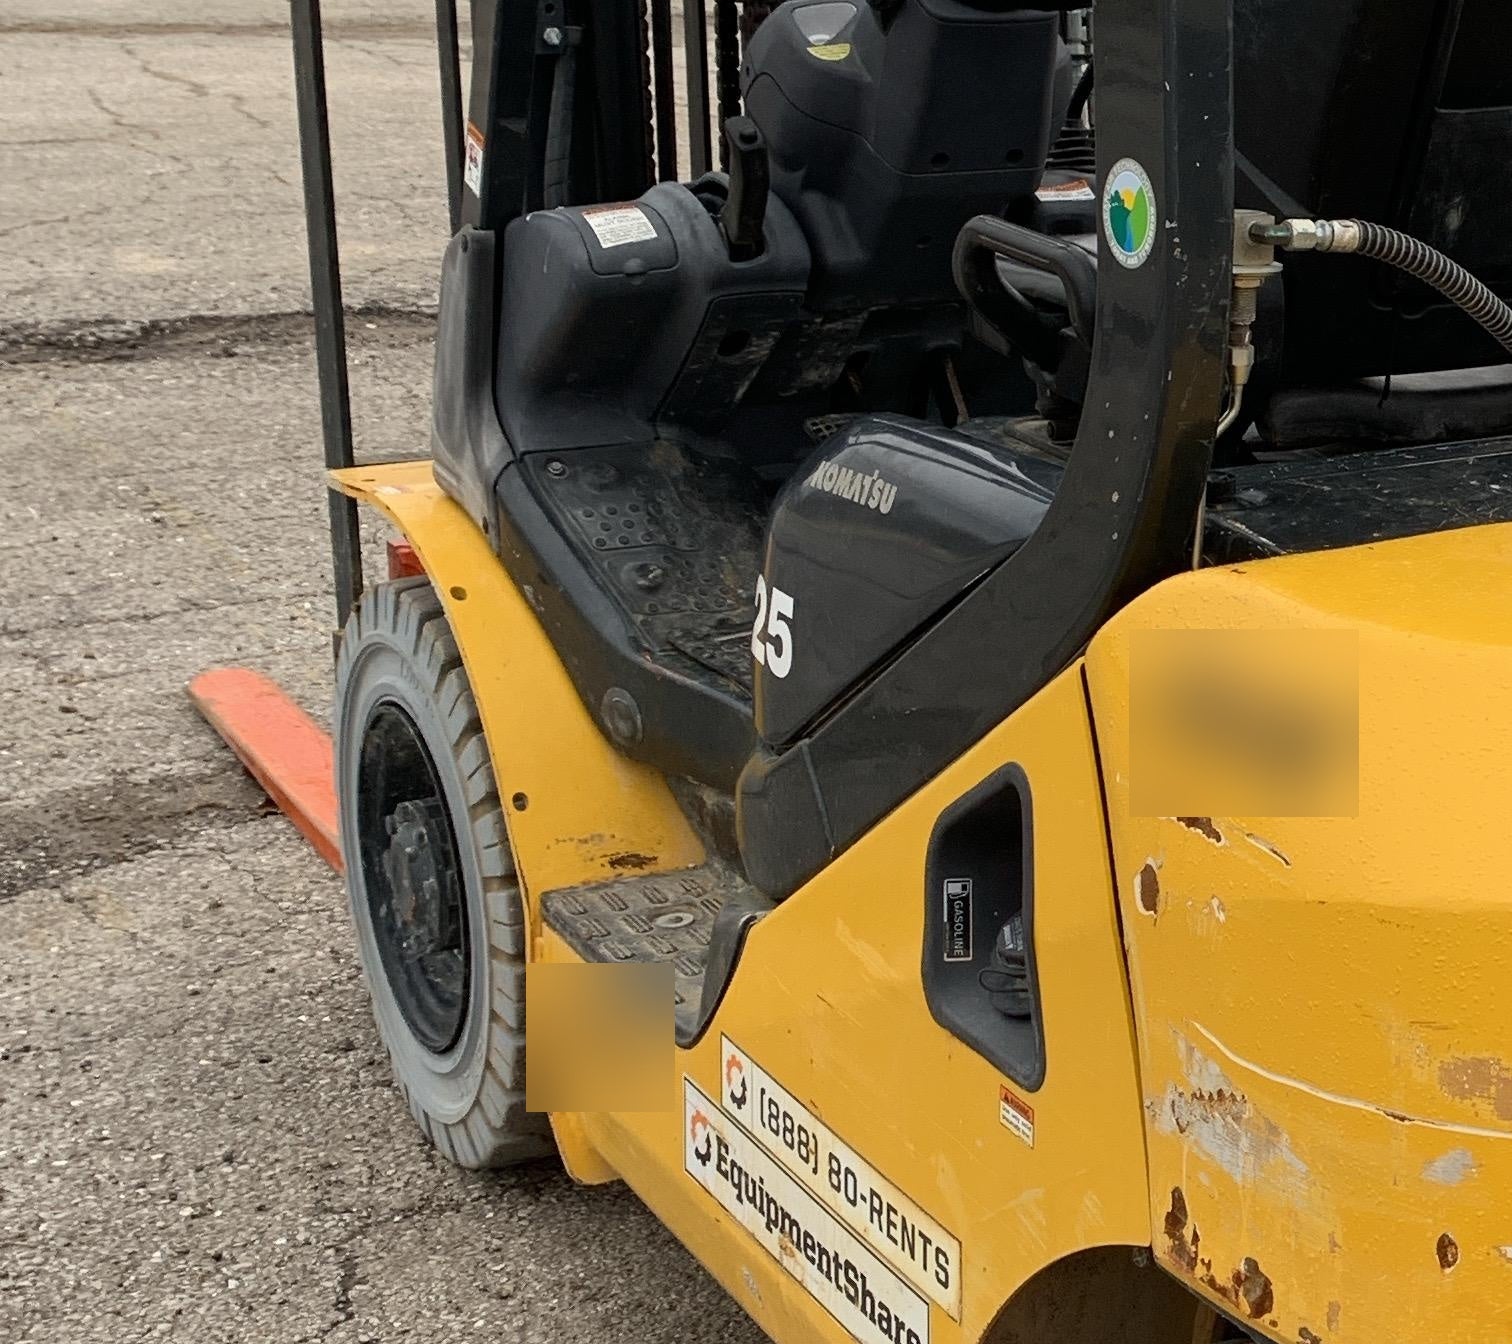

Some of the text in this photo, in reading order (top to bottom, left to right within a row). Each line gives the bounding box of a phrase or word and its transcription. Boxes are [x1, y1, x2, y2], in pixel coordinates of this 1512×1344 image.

[810, 460, 897, 515] KOMATSU
[751, 573, 794, 679] 25
[953, 900, 965, 957] GASOLINE
[760, 1087, 950, 1290] (888) 80-RENTS
